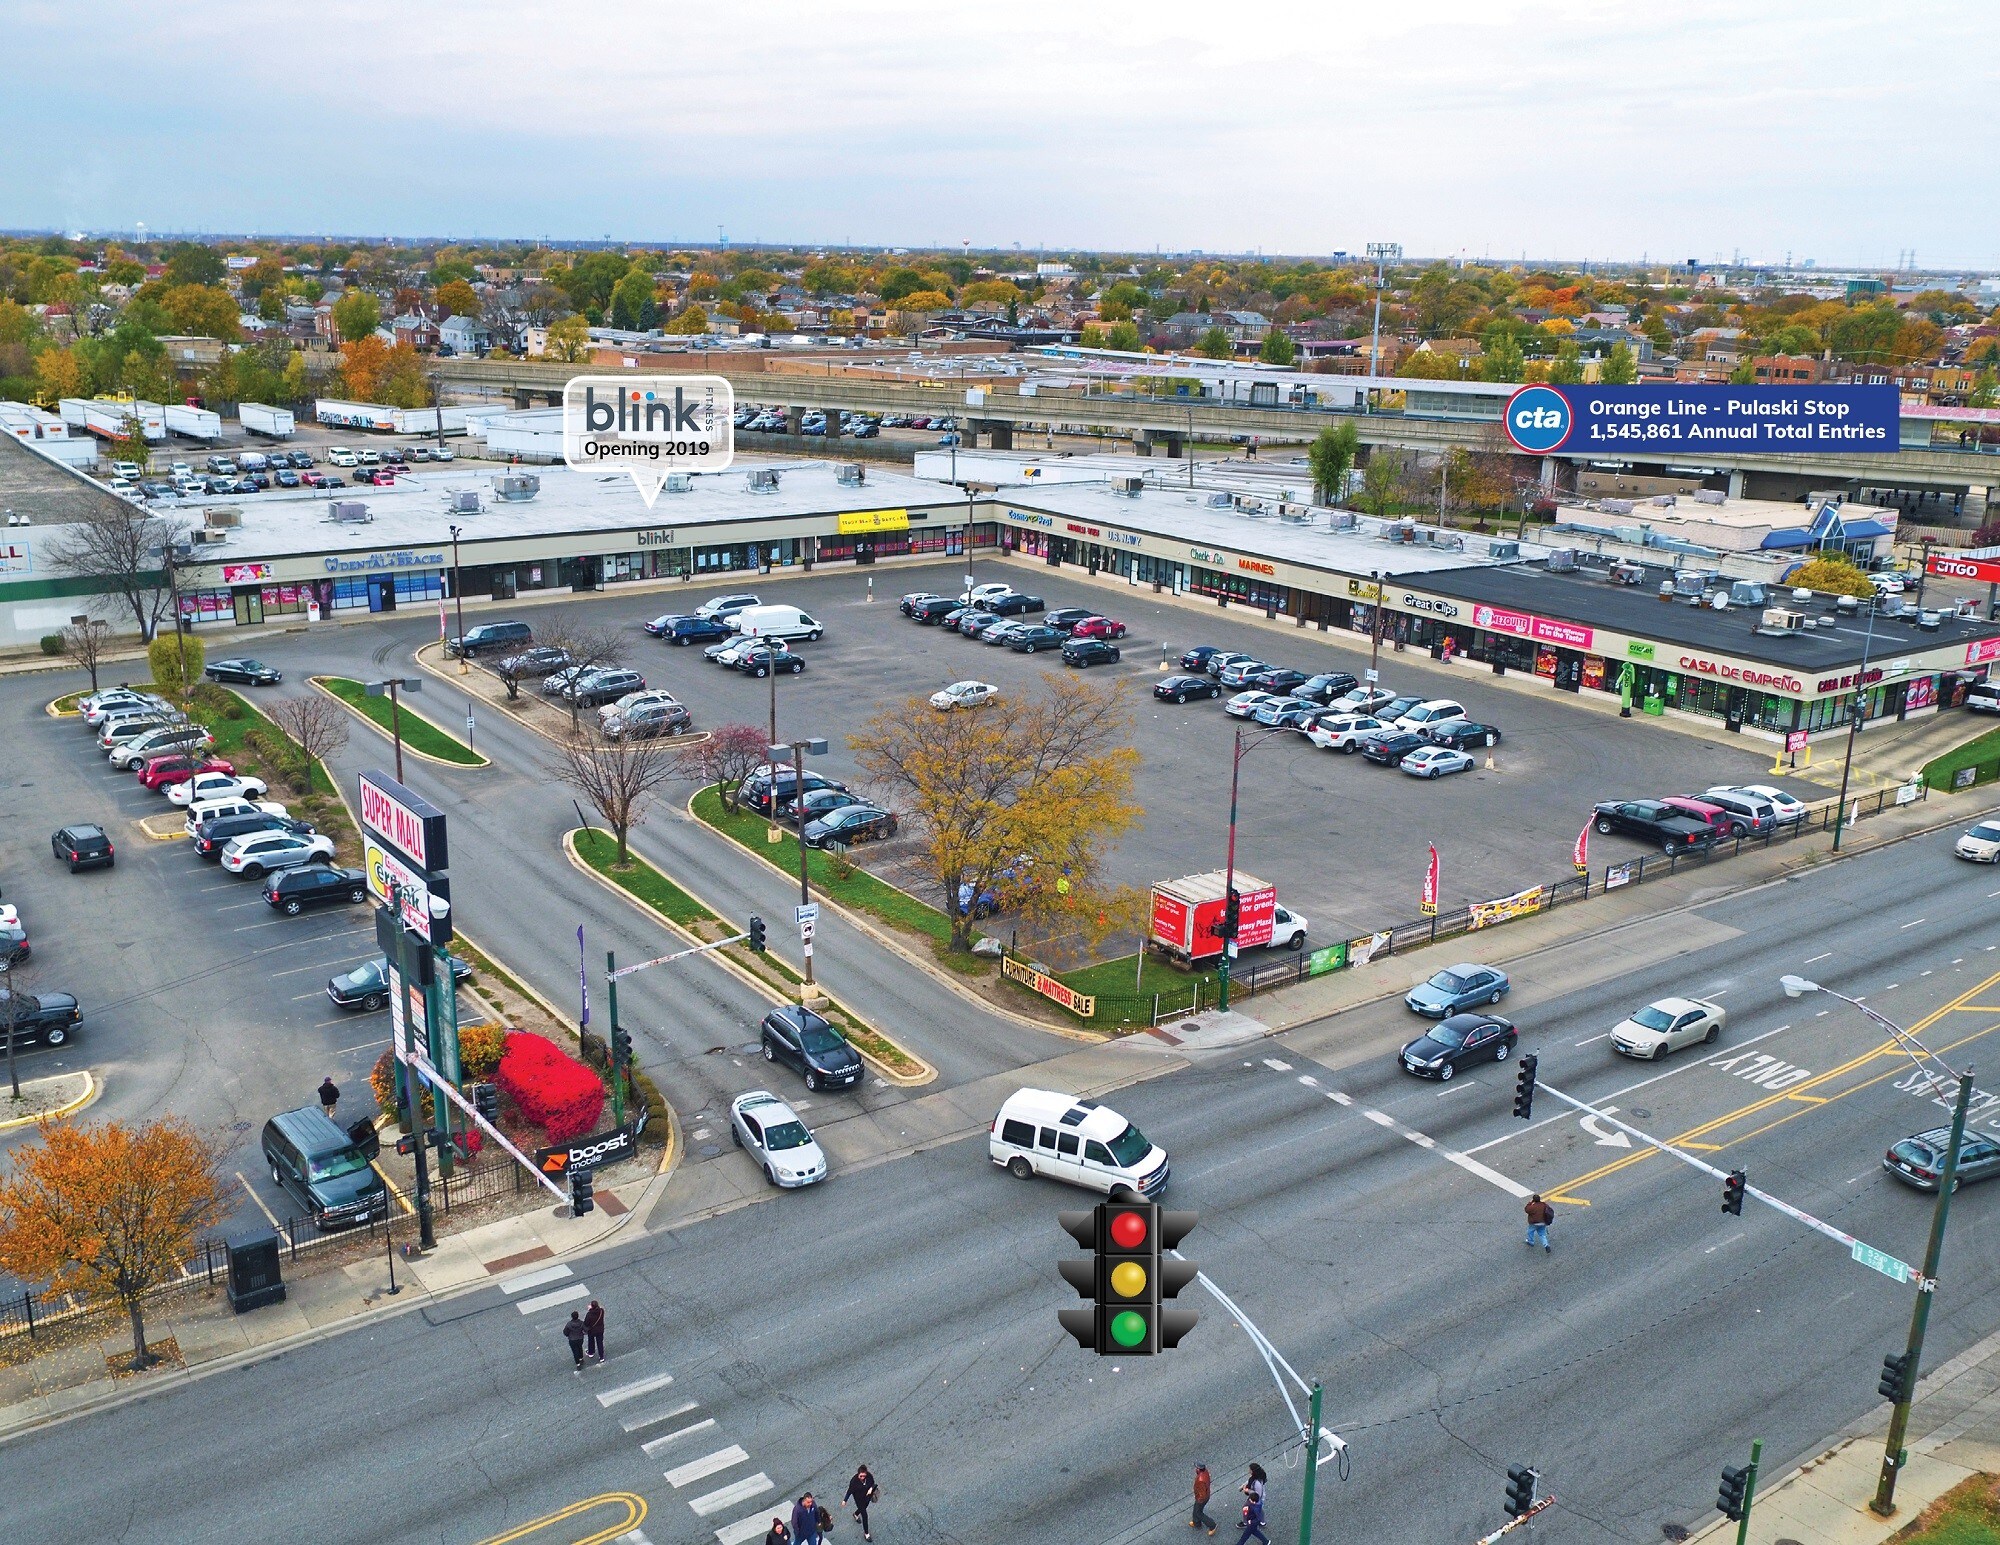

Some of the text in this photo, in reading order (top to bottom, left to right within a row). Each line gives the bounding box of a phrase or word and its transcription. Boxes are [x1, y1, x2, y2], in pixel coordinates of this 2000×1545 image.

[638, 530, 670, 546] blink
[396, 554, 444, 567] BRACES
[1238, 559, 1275, 576] MARINES
[1936, 560, 1978, 577] CITGO
[1403, 593, 1458, 617] Great Clips
[1491, 614, 1528, 628] MEZQUITE
[1679, 656, 1802, 694] CASA DE EMPEÑO
[1790, 732, 1805, 743] NOW
[1790, 740, 1806, 751] OPEN
[363, 783, 423, 861] SUPER MALL
[1254, 891, 1274, 902] place
[1241, 903, 1252, 913] for
[1255, 918, 1272, 927] Plaza
[1005, 959, 1090, 1014] FURNITURE & MATTRESS SALE
[1709, 1050, 1811, 1090] ONLY
[569, 1132, 628, 1163] boost
[570, 1154, 602, 1170] mobile
